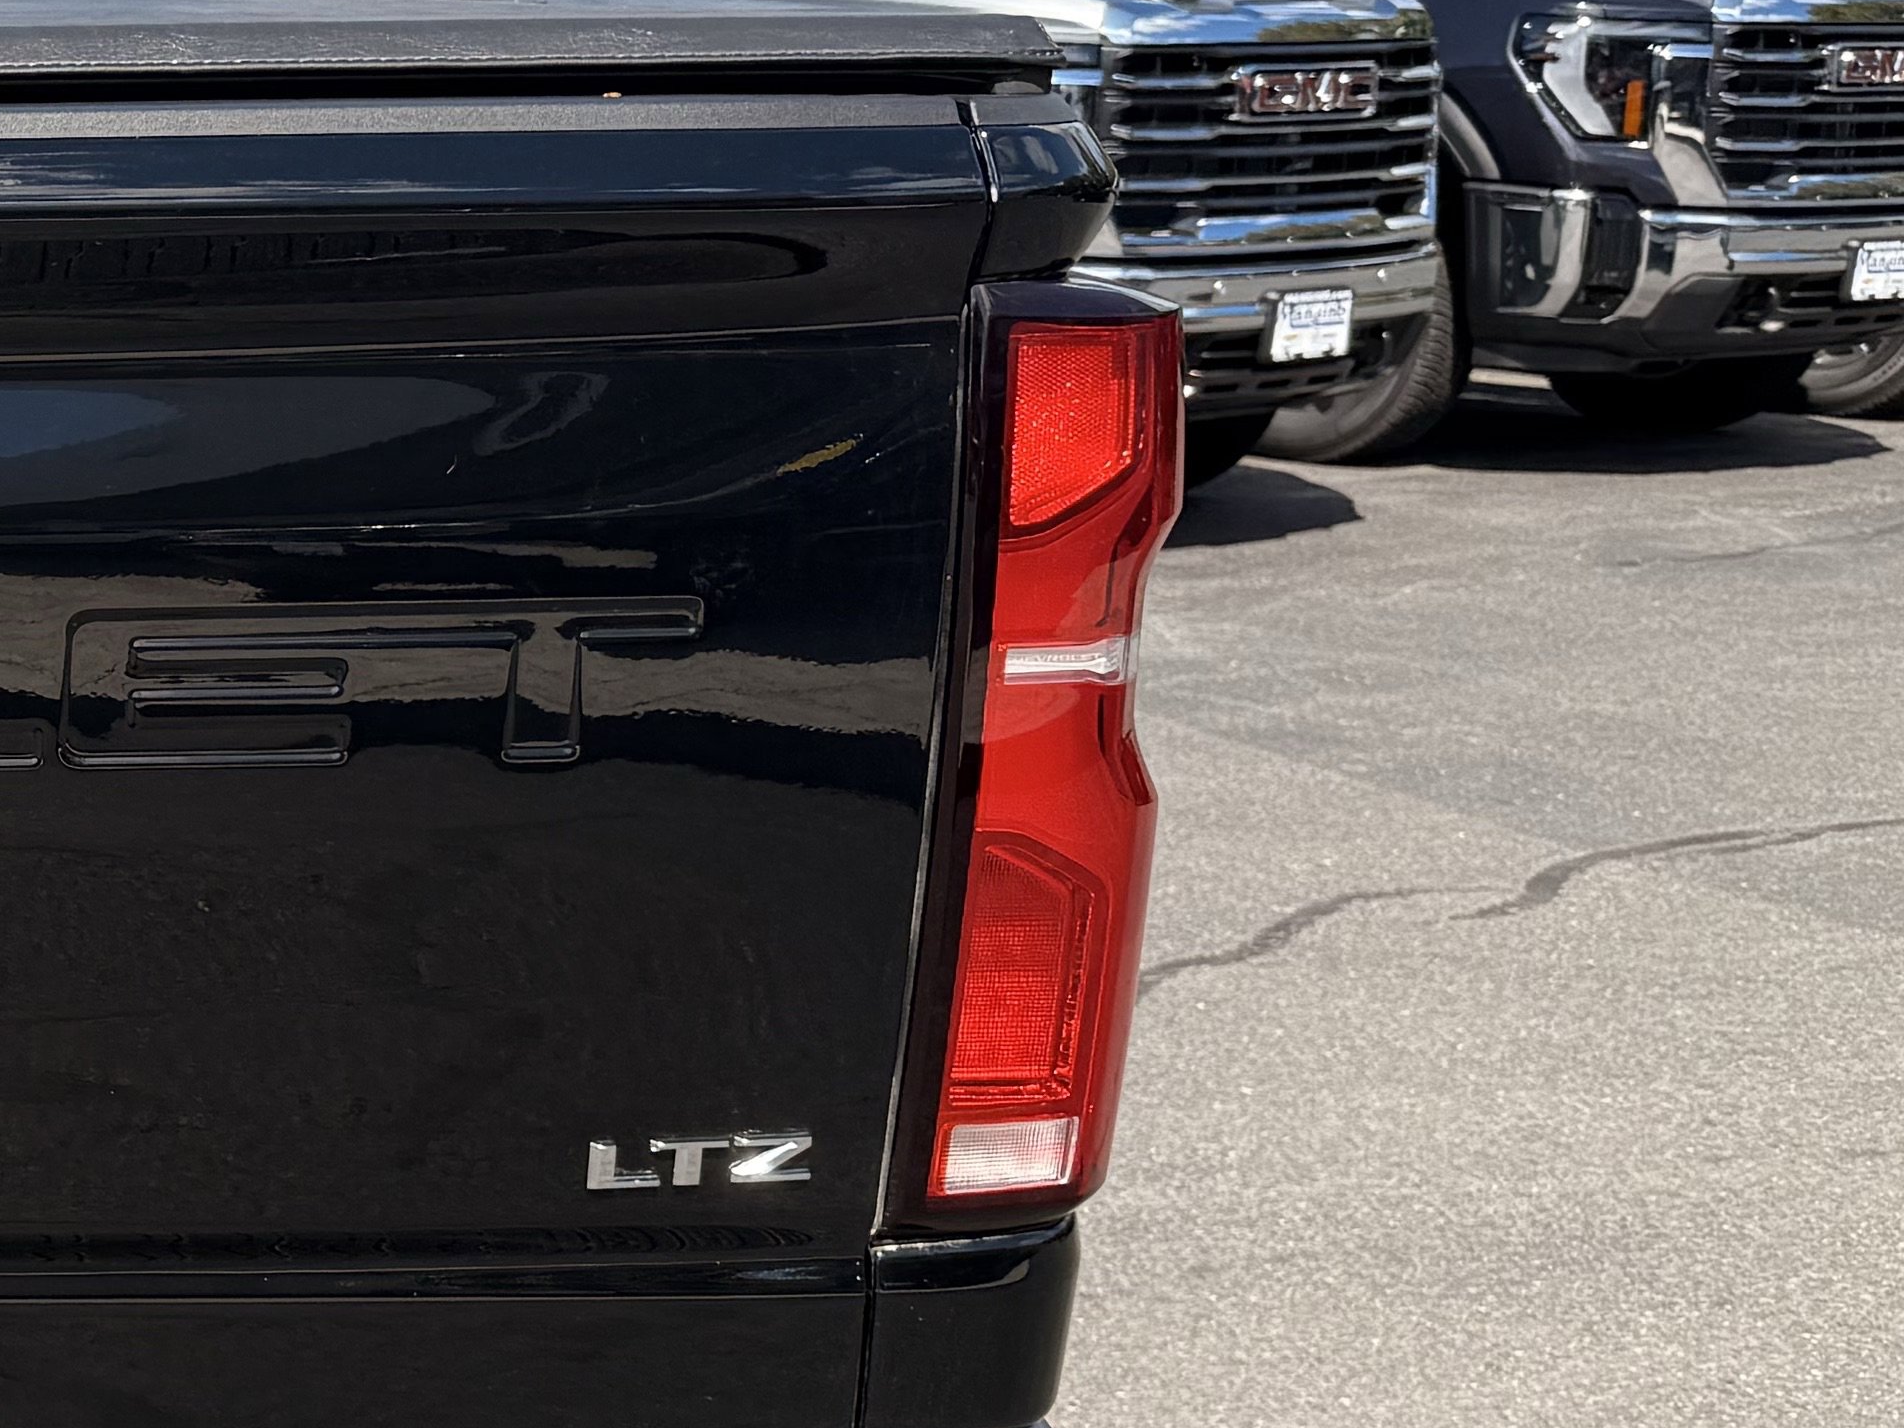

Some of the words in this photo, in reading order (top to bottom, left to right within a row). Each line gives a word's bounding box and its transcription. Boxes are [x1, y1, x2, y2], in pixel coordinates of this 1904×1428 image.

[1839, 49, 1904, 84] GM
[1253, 72, 1376, 113] GMC
[587, 1131, 813, 1190] LTZ
